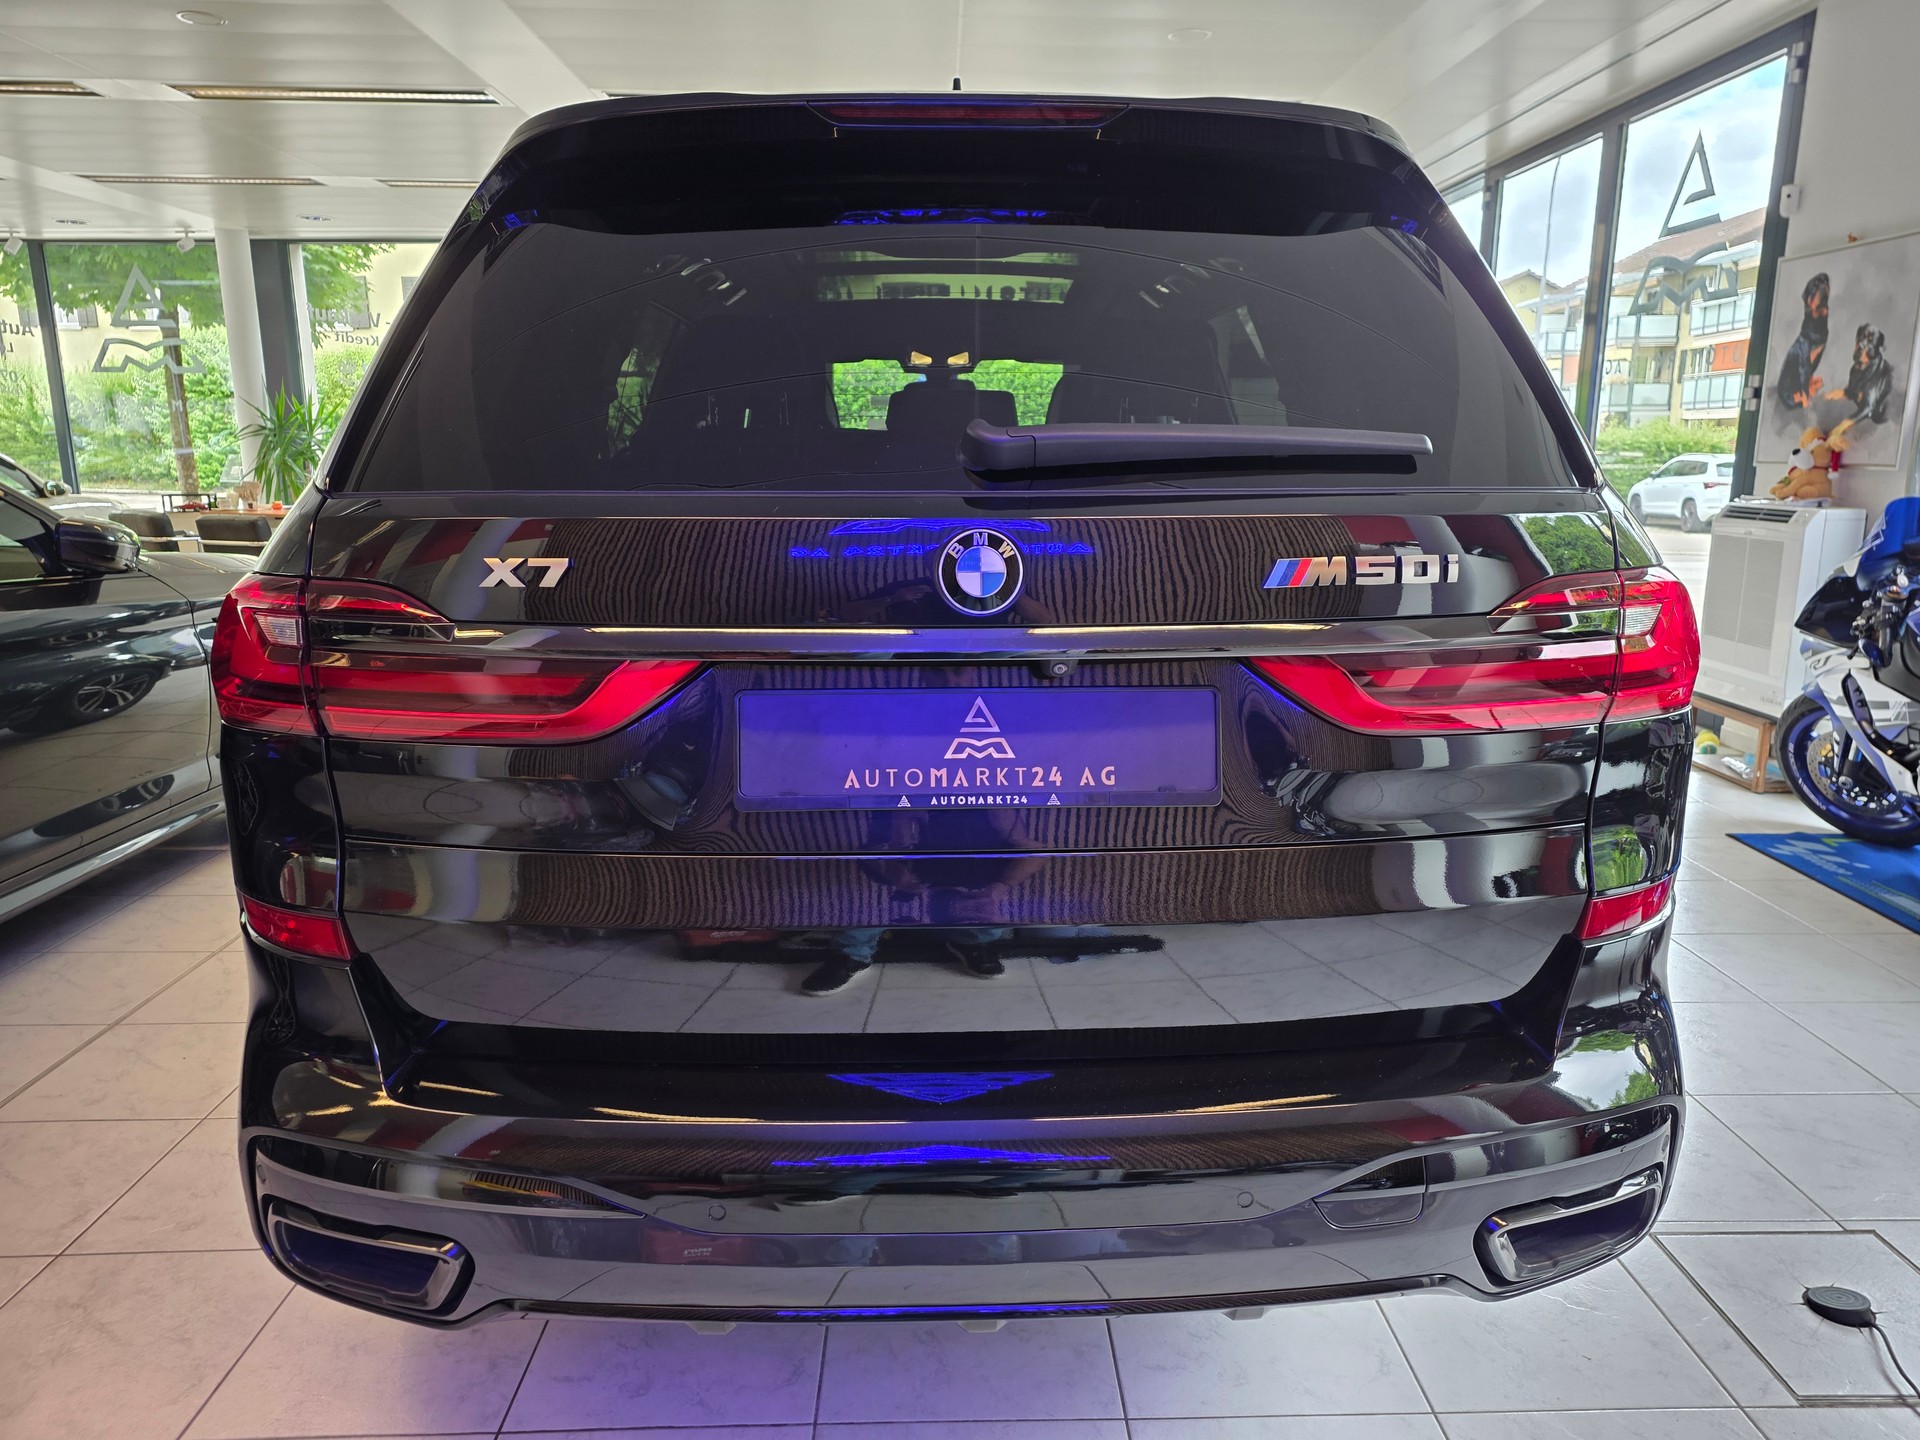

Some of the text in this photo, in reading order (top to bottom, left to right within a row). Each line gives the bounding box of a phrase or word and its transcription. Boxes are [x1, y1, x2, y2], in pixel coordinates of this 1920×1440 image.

[947, 531, 1016, 560] BMW
[478, 557, 570, 588] X7
[844, 765, 1116, 788] AUTOMARKT24 AG
[930, 795, 1028, 805] AUTOMARKT24
